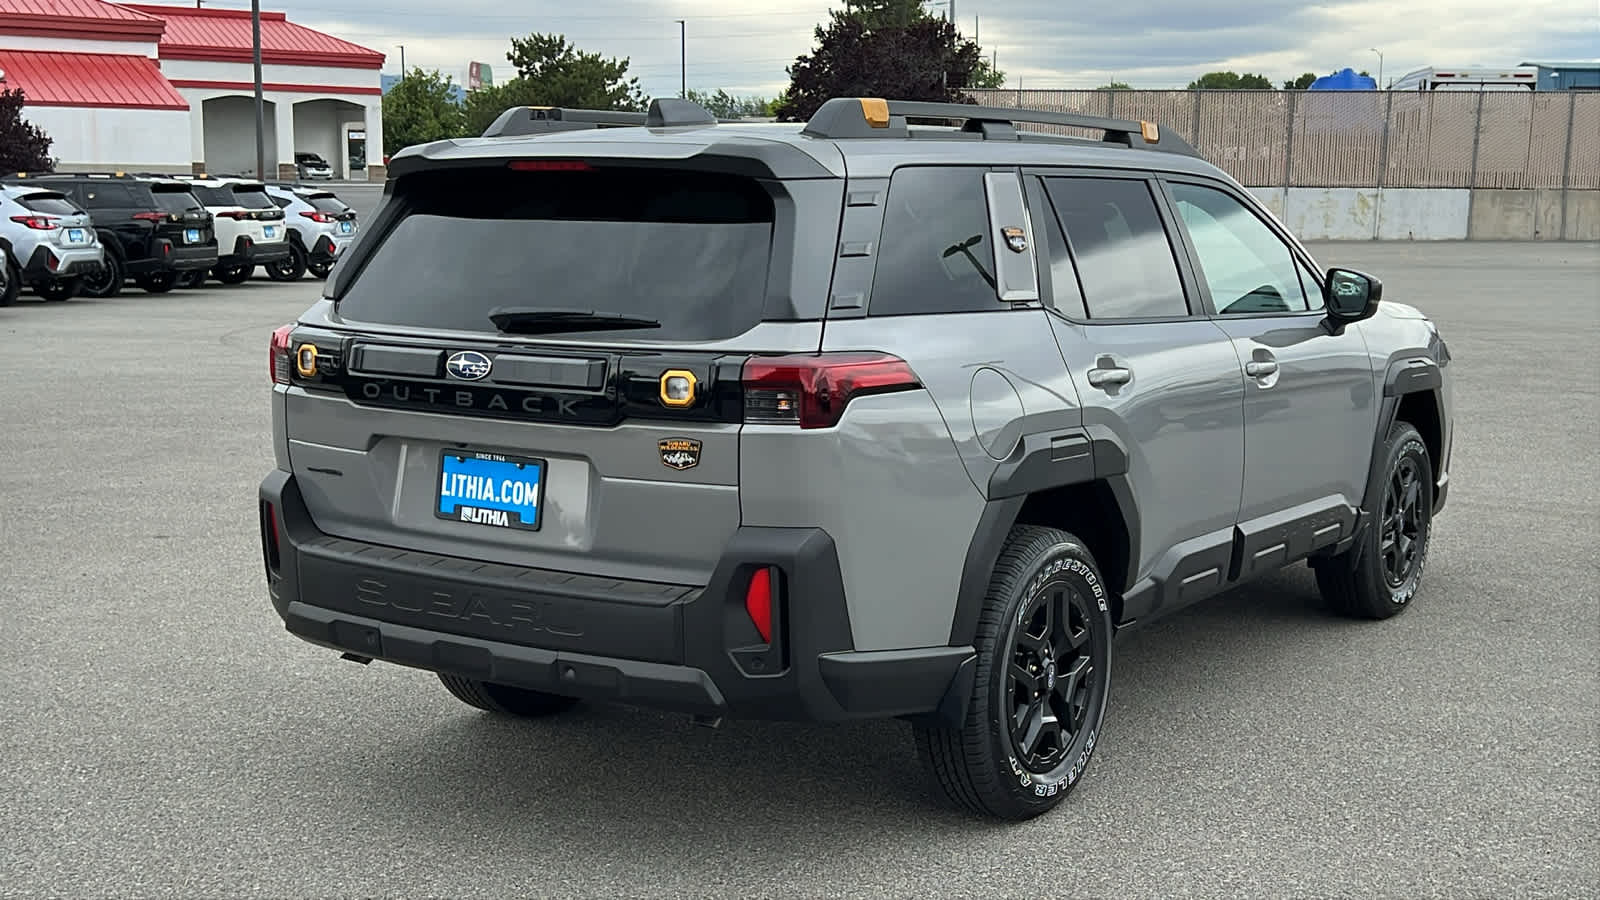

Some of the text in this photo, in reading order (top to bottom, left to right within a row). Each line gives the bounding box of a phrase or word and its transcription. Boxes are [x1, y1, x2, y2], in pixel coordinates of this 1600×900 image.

[363, 383, 577, 416] OUTBACK
[475, 452, 492, 461] SINCE
[441, 472, 539, 508] LITHIA.COM
[472, 507, 509, 527] LITHIA
[1035, 730, 1096, 797] DUELER
